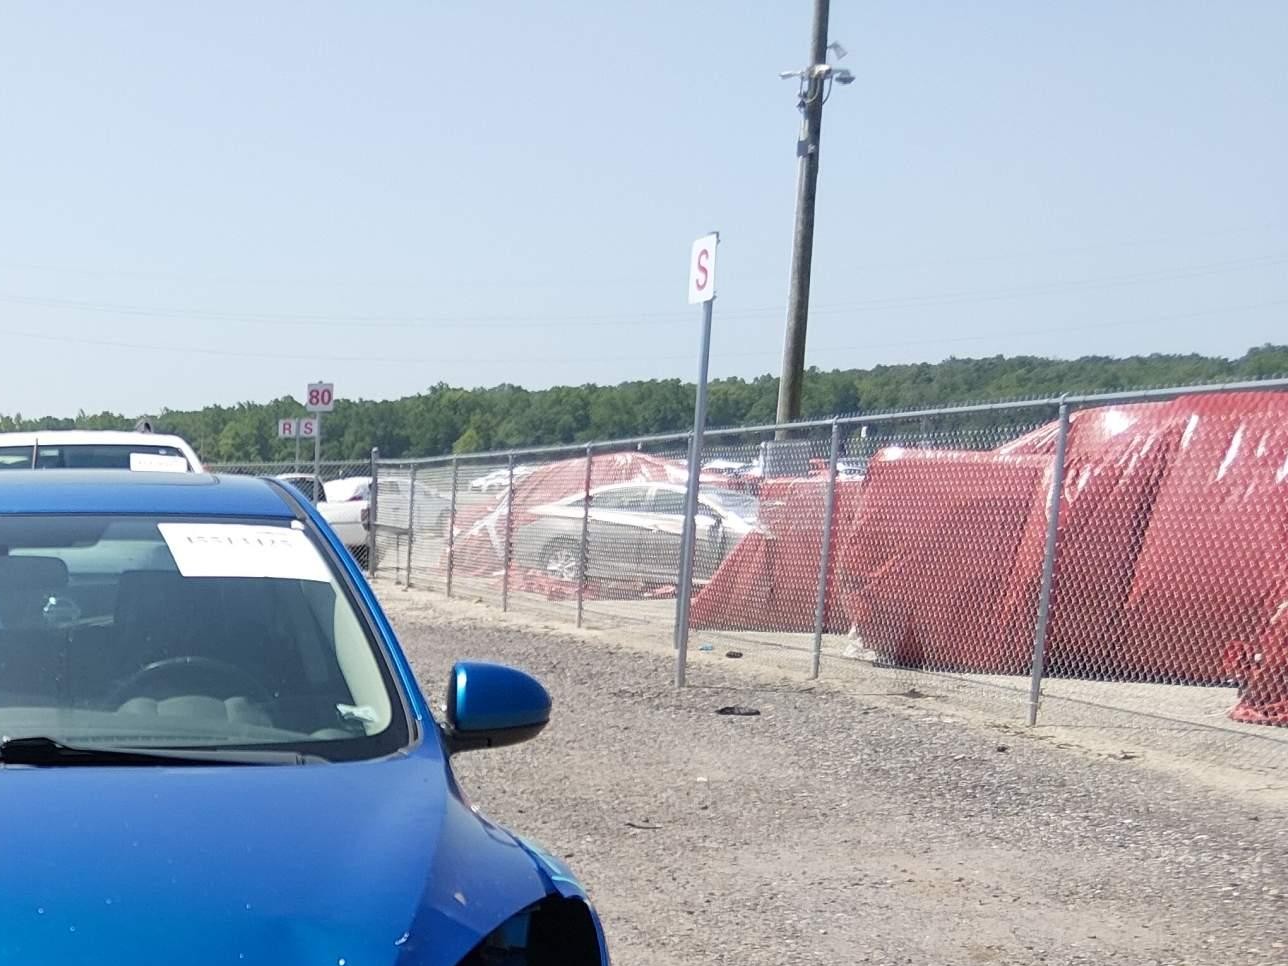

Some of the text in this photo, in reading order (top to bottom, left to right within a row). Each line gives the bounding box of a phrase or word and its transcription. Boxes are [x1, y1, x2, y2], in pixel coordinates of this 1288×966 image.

[696, 248, 709, 291] S
[309, 389, 332, 406] 80
[282, 422, 313, 435] R S
